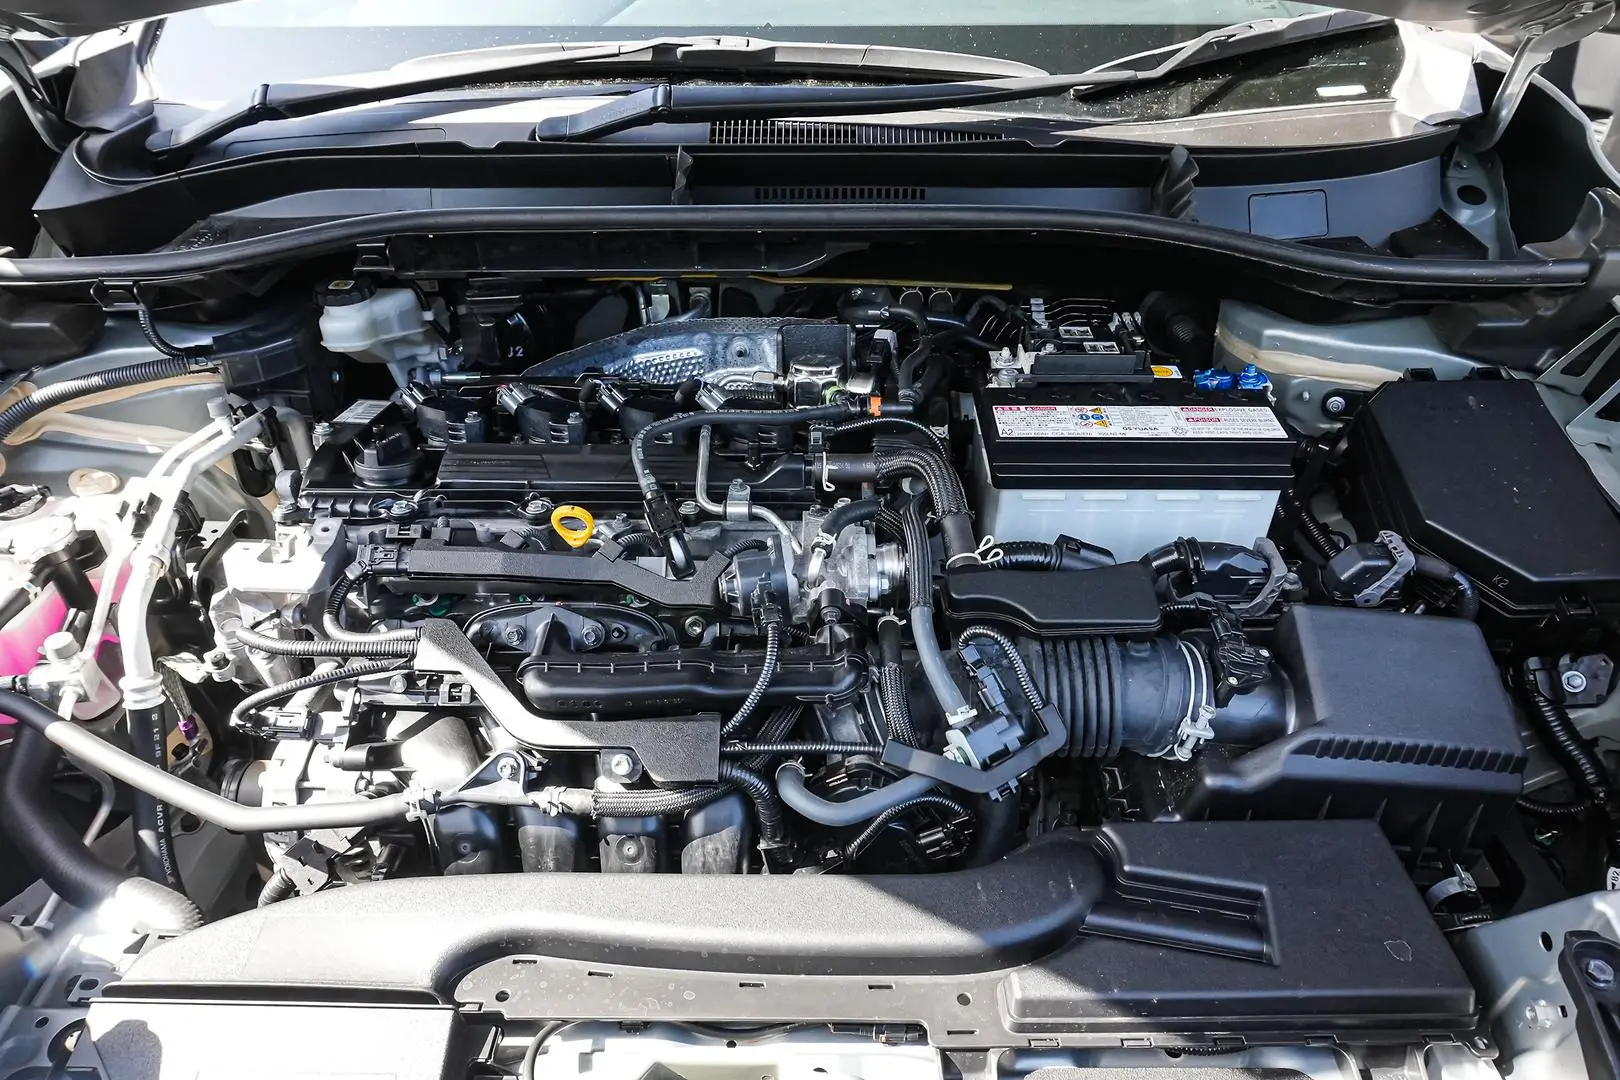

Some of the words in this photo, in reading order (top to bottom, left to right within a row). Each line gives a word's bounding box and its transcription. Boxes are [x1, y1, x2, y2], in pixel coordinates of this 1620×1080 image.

[507, 345, 525, 358] J2
[1001, 428, 1013, 436] A2
[1492, 574, 1509, 588] K2
[156, 804, 164, 832] ACVR
[160, 838, 172, 875] YOKOHAMA
